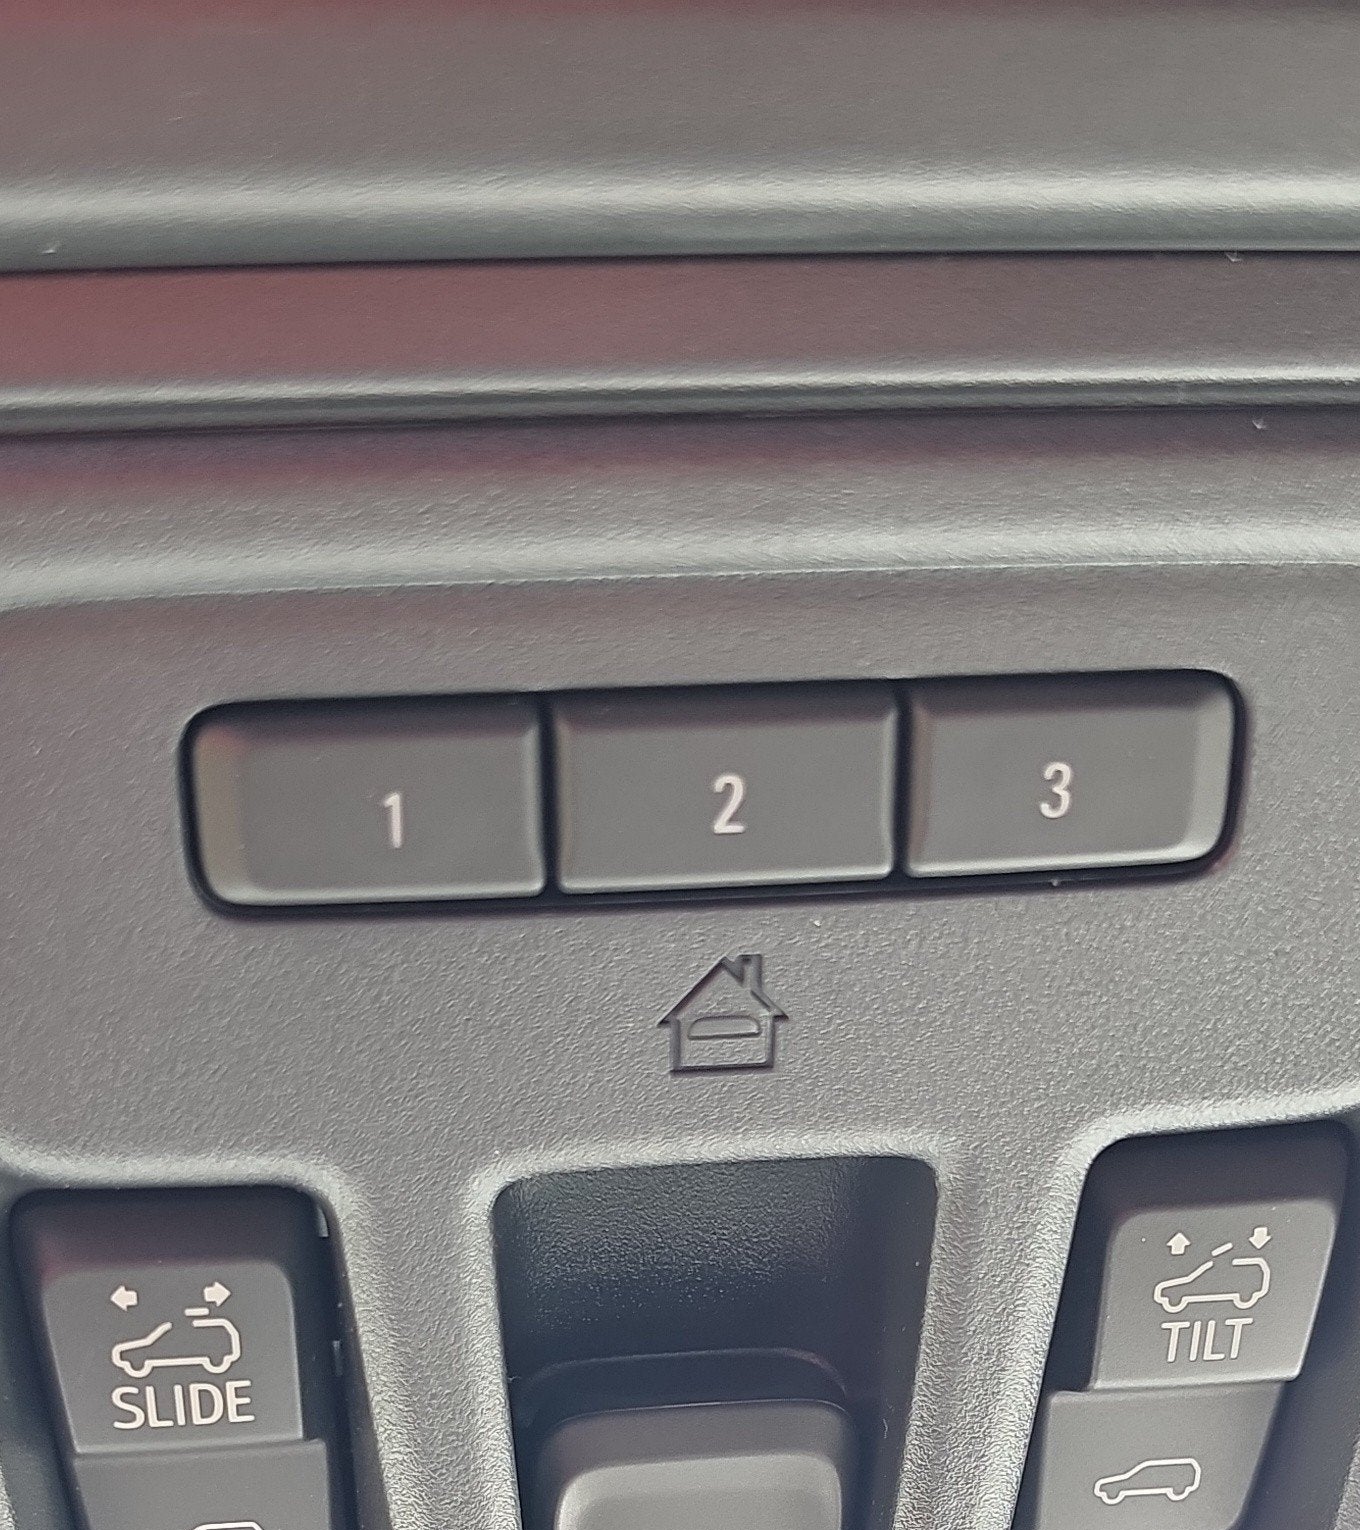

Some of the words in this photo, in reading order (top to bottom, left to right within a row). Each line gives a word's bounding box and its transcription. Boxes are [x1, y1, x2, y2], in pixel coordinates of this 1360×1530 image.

[712, 774, 746, 835] 2
[1040, 762, 1073, 820] 3
[382, 792, 403, 849] 1
[1161, 1317, 1254, 1363] TILT
[111, 1379, 256, 1429] SLIDE
